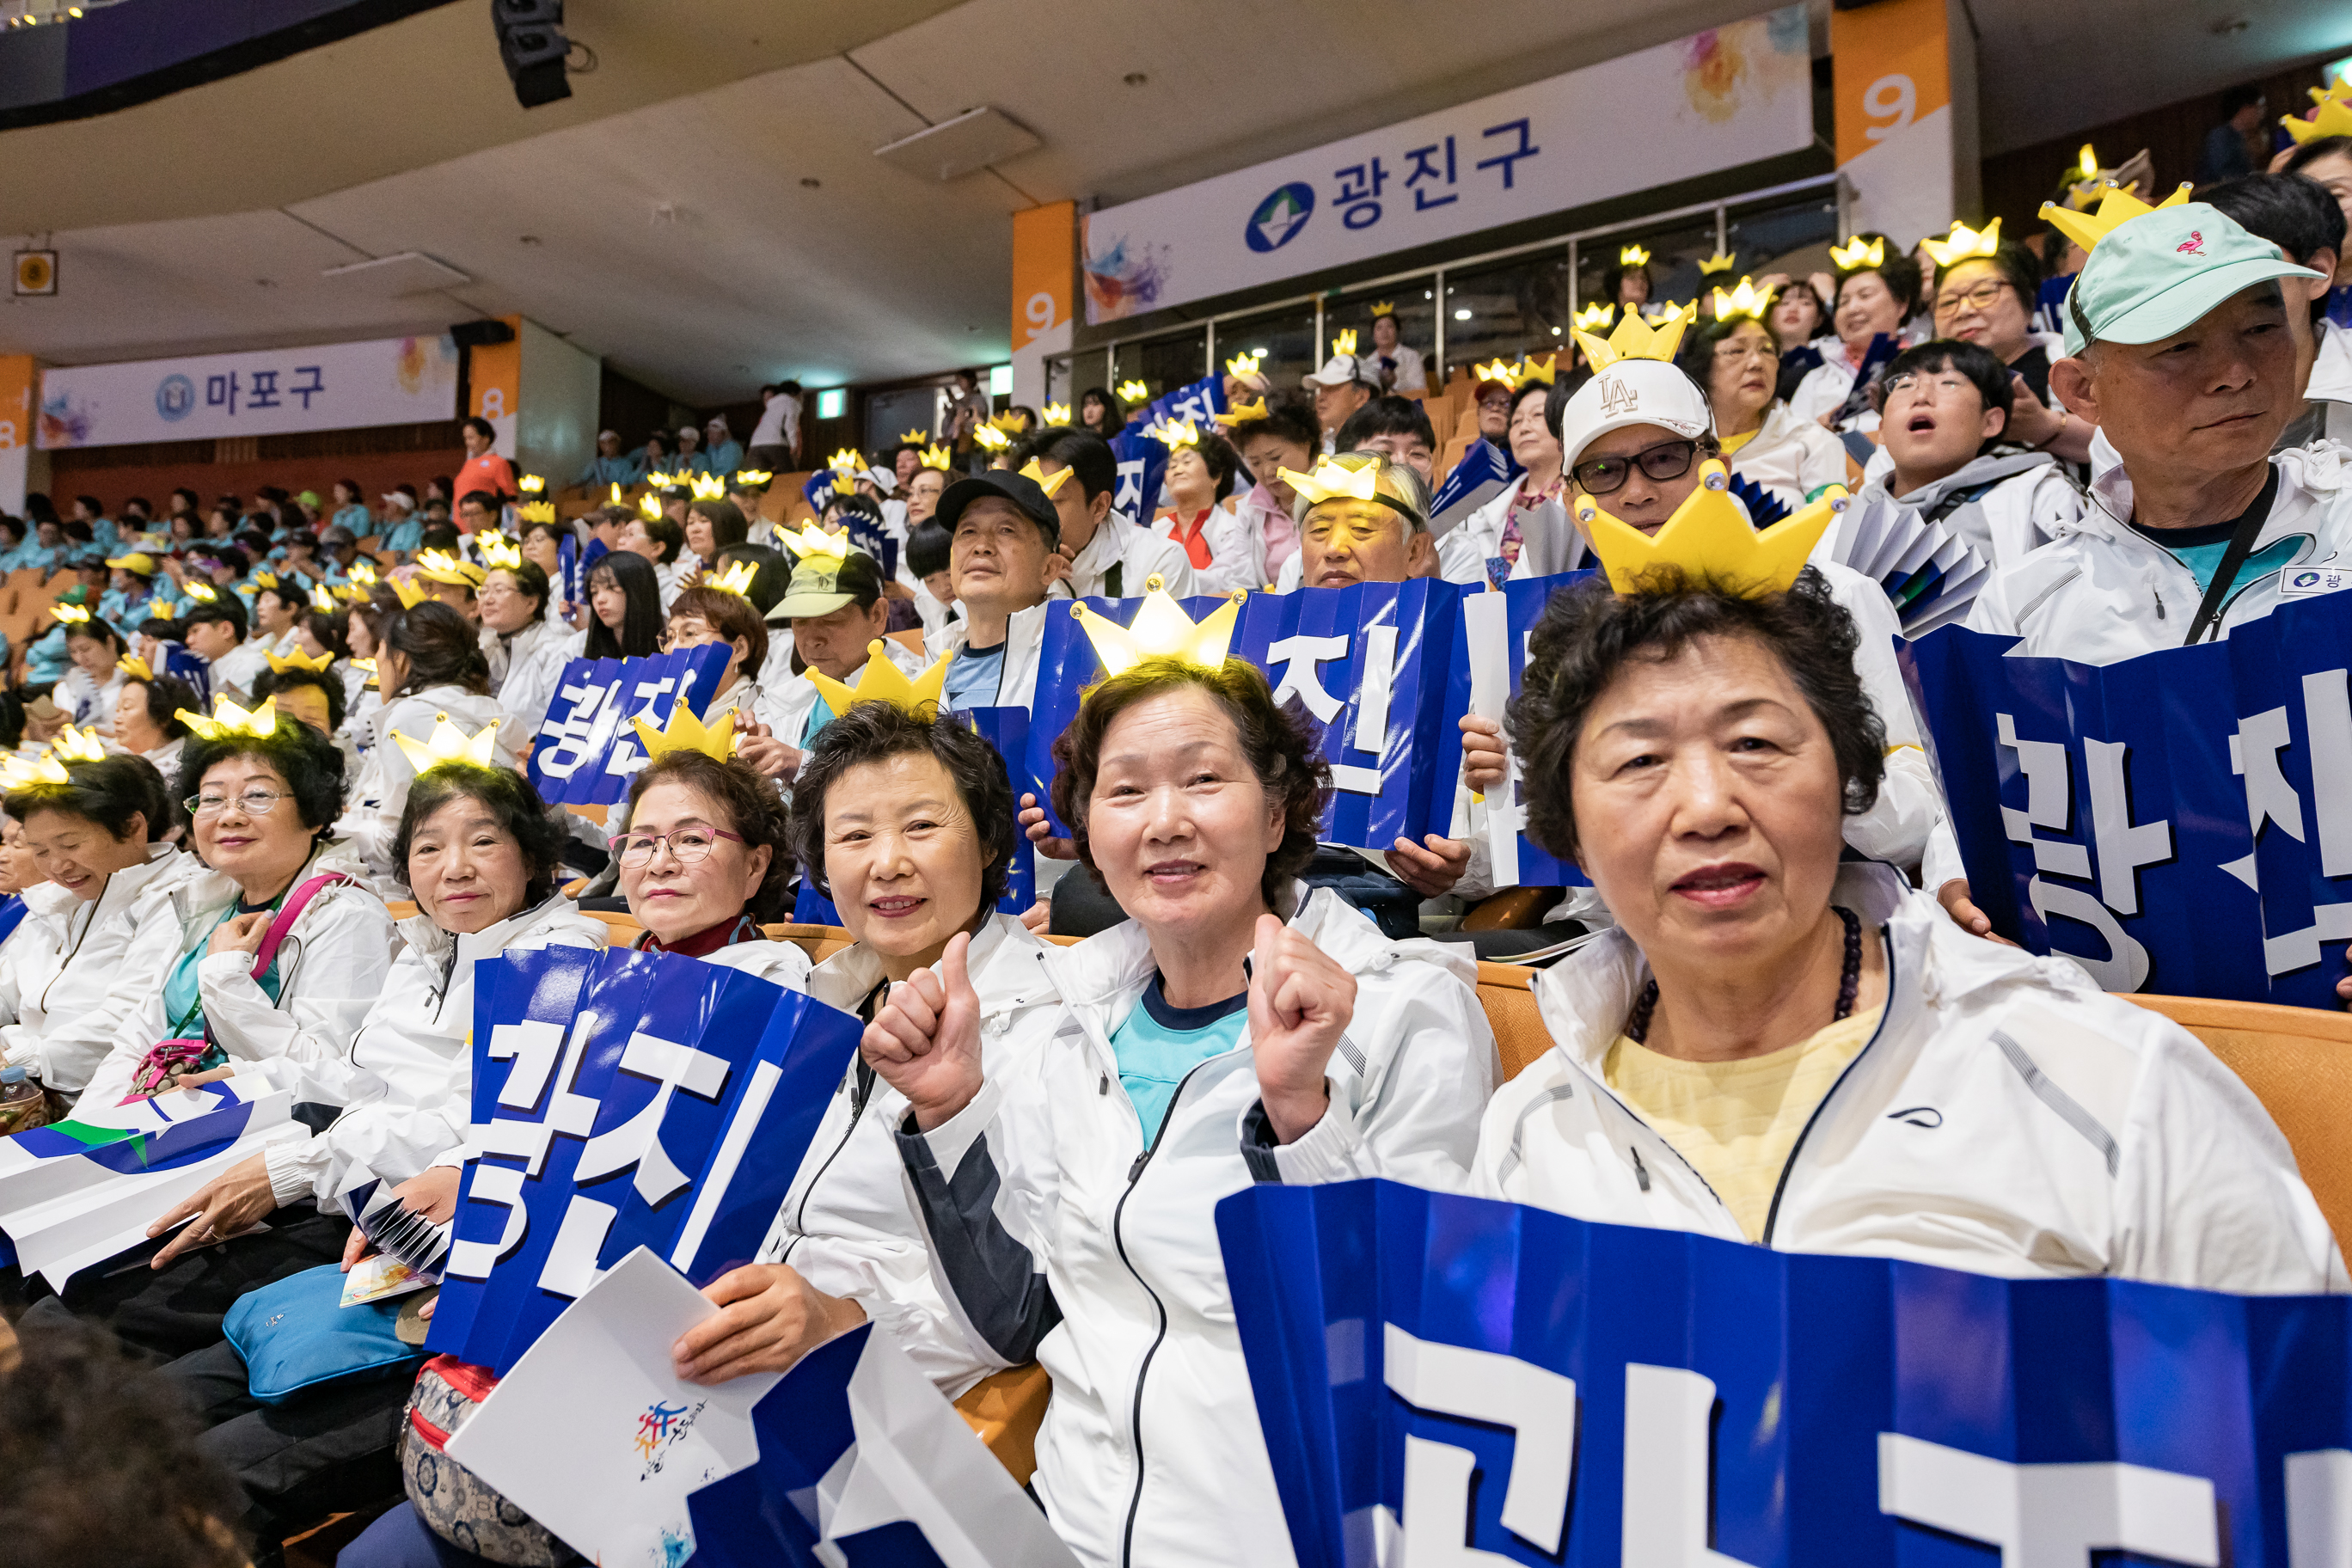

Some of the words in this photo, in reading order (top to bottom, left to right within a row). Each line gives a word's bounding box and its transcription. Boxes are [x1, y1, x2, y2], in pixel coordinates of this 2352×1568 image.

[1863, 73, 1916, 141] 9
[1332, 117, 1540, 230] 광진구
[1026, 291, 1055, 340] 9
[206, 365, 325, 416] 마포구
[1598, 374, 1638, 419] LA
[538, 668, 698, 779] 광진
[1266, 624, 1399, 794] 진
[445, 1009, 784, 1300] 광진
